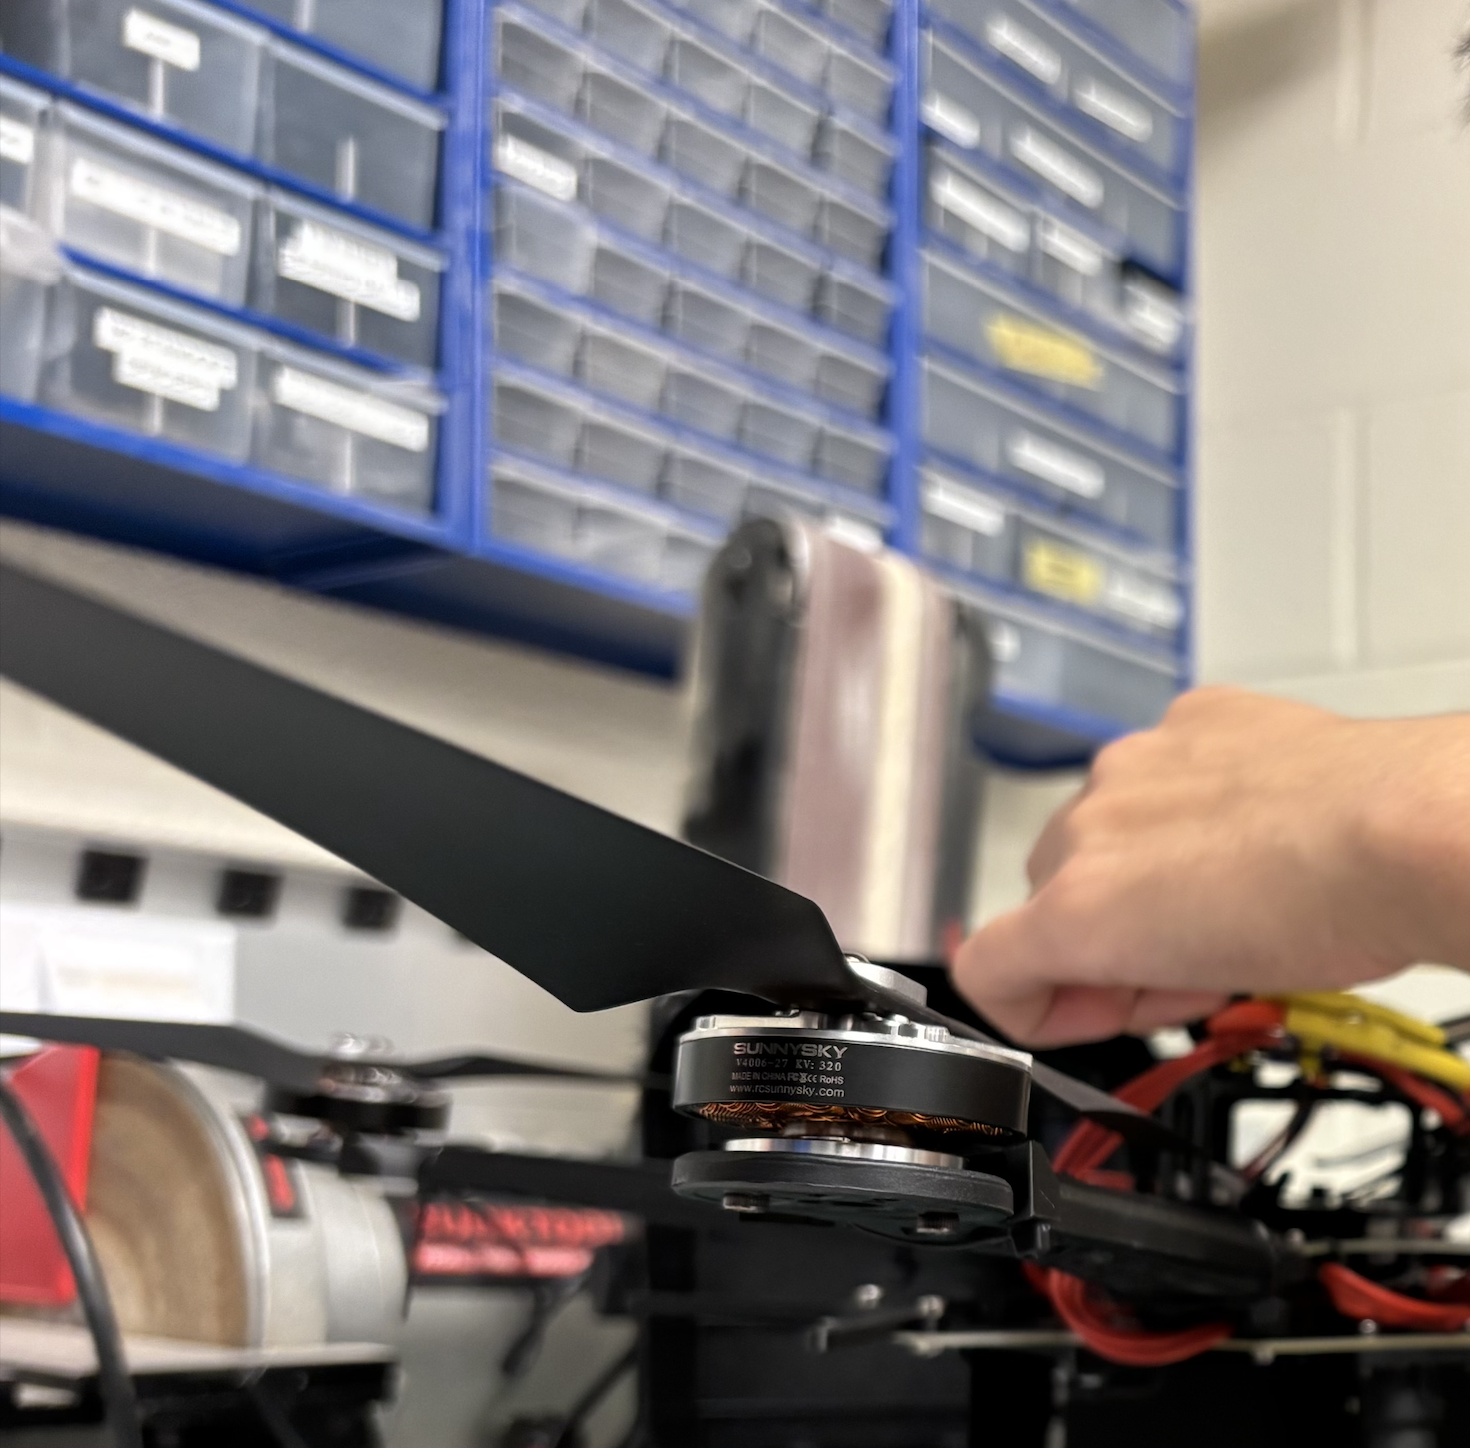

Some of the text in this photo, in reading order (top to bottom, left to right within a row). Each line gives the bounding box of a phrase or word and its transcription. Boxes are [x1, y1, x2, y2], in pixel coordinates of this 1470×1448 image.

[733, 1042, 848, 1059] SUNNYSKY
[795, 1059, 815, 1069] KV:
[819, 1061, 842, 1071] 320
[731, 1072, 752, 1080] MADE
[753, 1072, 760, 1080] IN
[761, 1072, 786, 1081] CHINA
[819, 1075, 844, 1085] RoHS
[729, 1084, 845, 1098] www.rcsunnysky.com
